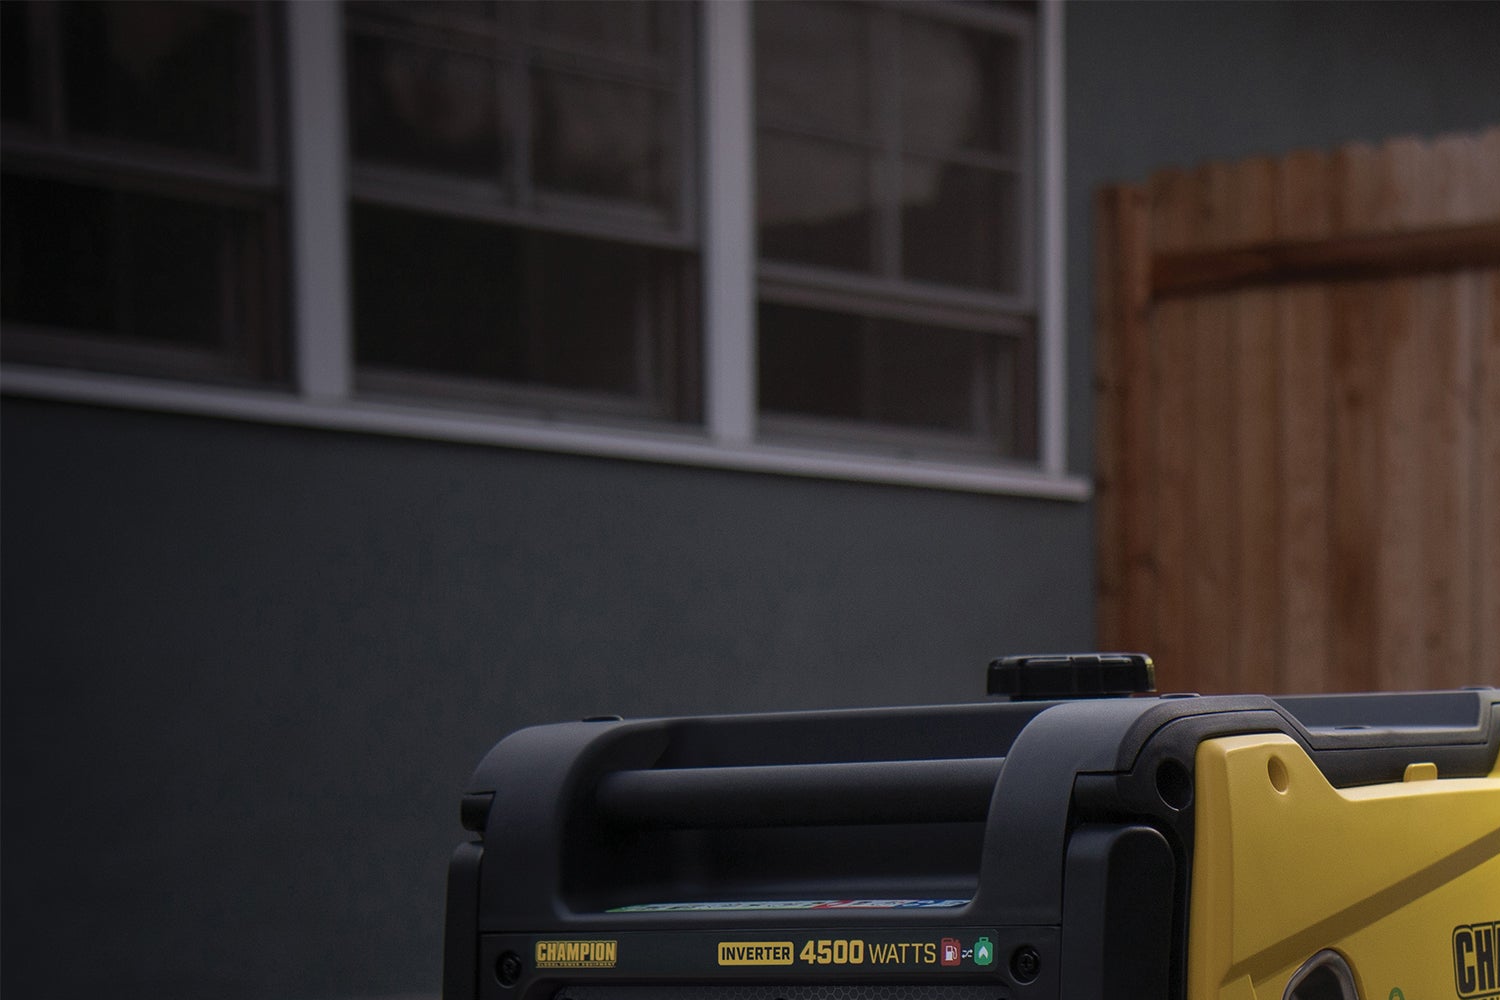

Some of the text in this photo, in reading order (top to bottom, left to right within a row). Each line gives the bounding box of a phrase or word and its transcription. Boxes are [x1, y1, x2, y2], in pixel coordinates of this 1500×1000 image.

[537, 942, 616, 961] CHAMPION
[721, 940, 936, 965] INVERTER 4500 WATTS
